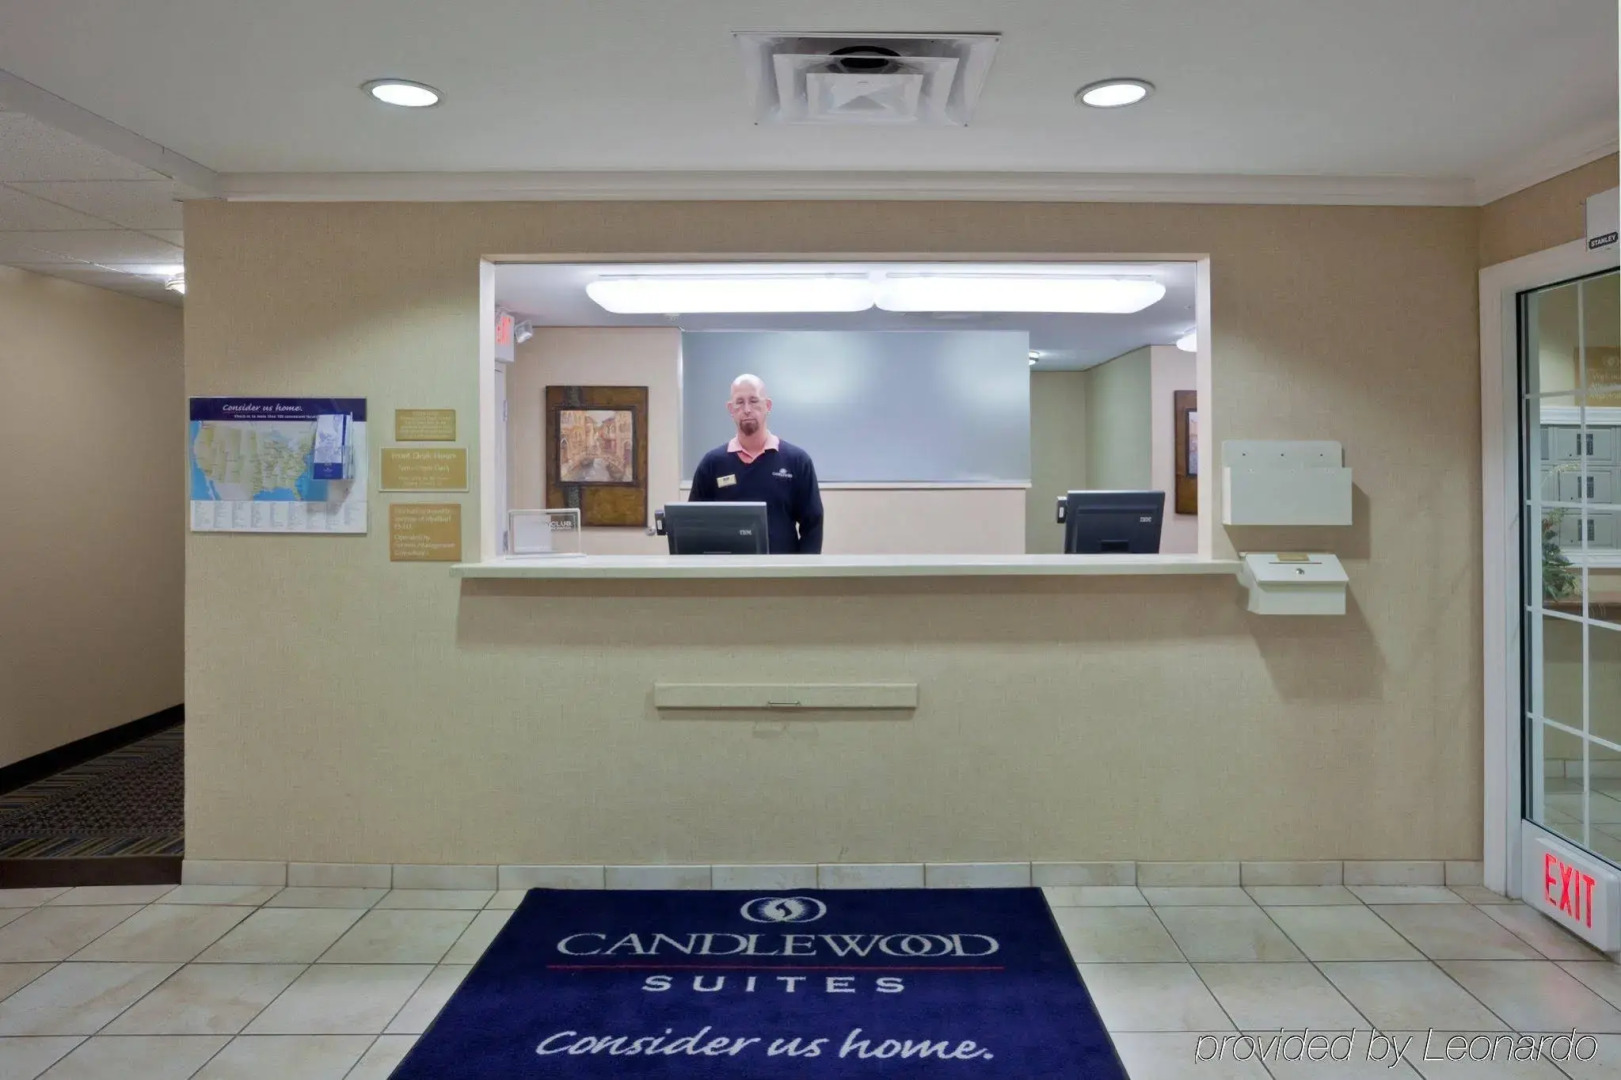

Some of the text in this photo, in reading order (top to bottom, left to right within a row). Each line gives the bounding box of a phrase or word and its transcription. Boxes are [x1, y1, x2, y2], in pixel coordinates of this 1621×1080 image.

[1590, 233, 1617, 248] STANLEY
[222, 403, 261, 411] Consider
[275, 402, 303, 412] home.
[1544, 852, 1596, 929] EXIT
[556, 932, 1000, 957] CANDLEWOOD
[641, 974, 905, 994] SUITES
[535, 1025, 995, 1060] Consider us home.
